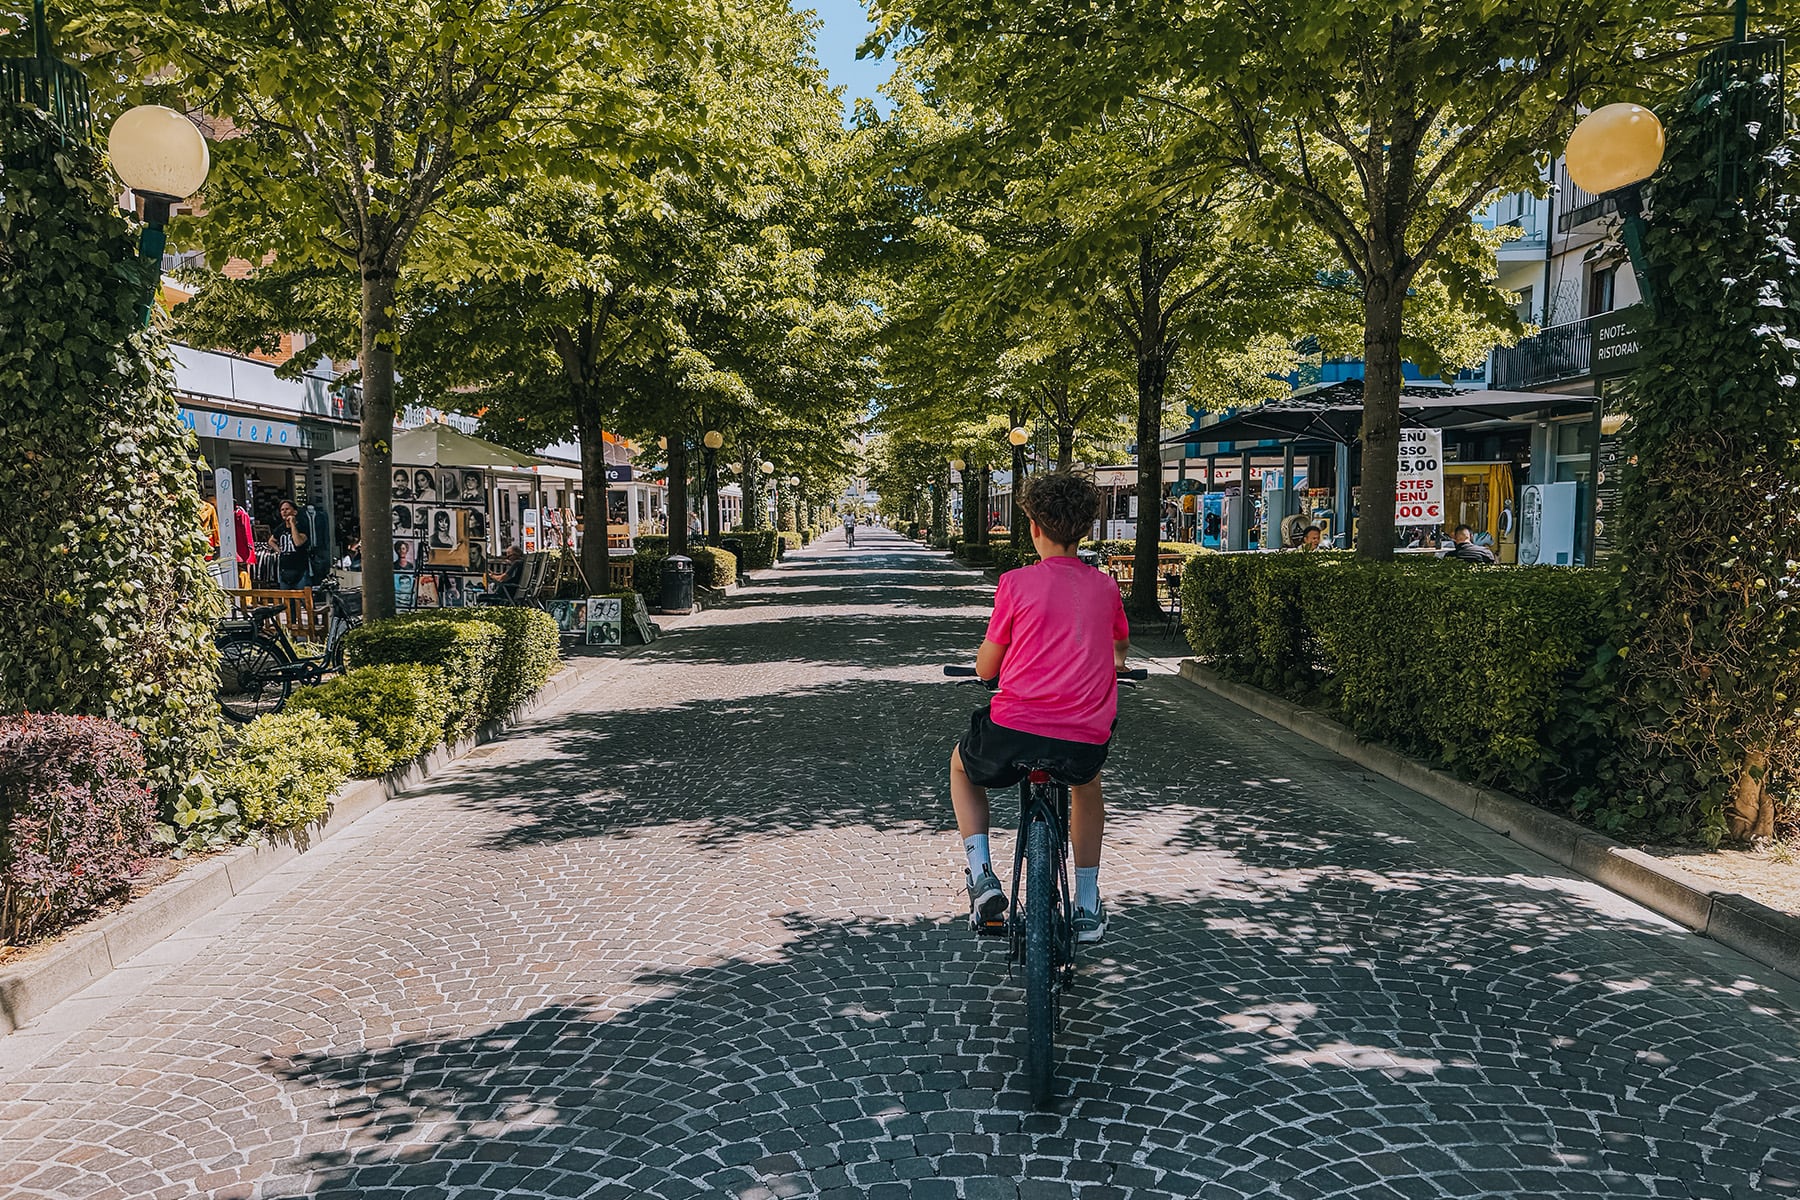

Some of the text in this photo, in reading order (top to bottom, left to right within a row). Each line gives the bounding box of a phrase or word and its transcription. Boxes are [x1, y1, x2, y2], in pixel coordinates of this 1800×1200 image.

[1600, 323, 1637, 341] ENOTE
[1598, 341, 1643, 360] RISTORAN
[210, 412, 287, 443] Piero
[1400, 430, 1426, 442] ENÙ
[1400, 446, 1427, 456] SSO
[1396, 489, 1428, 502] ENÜ
[1395, 506, 1423, 519] ,00
